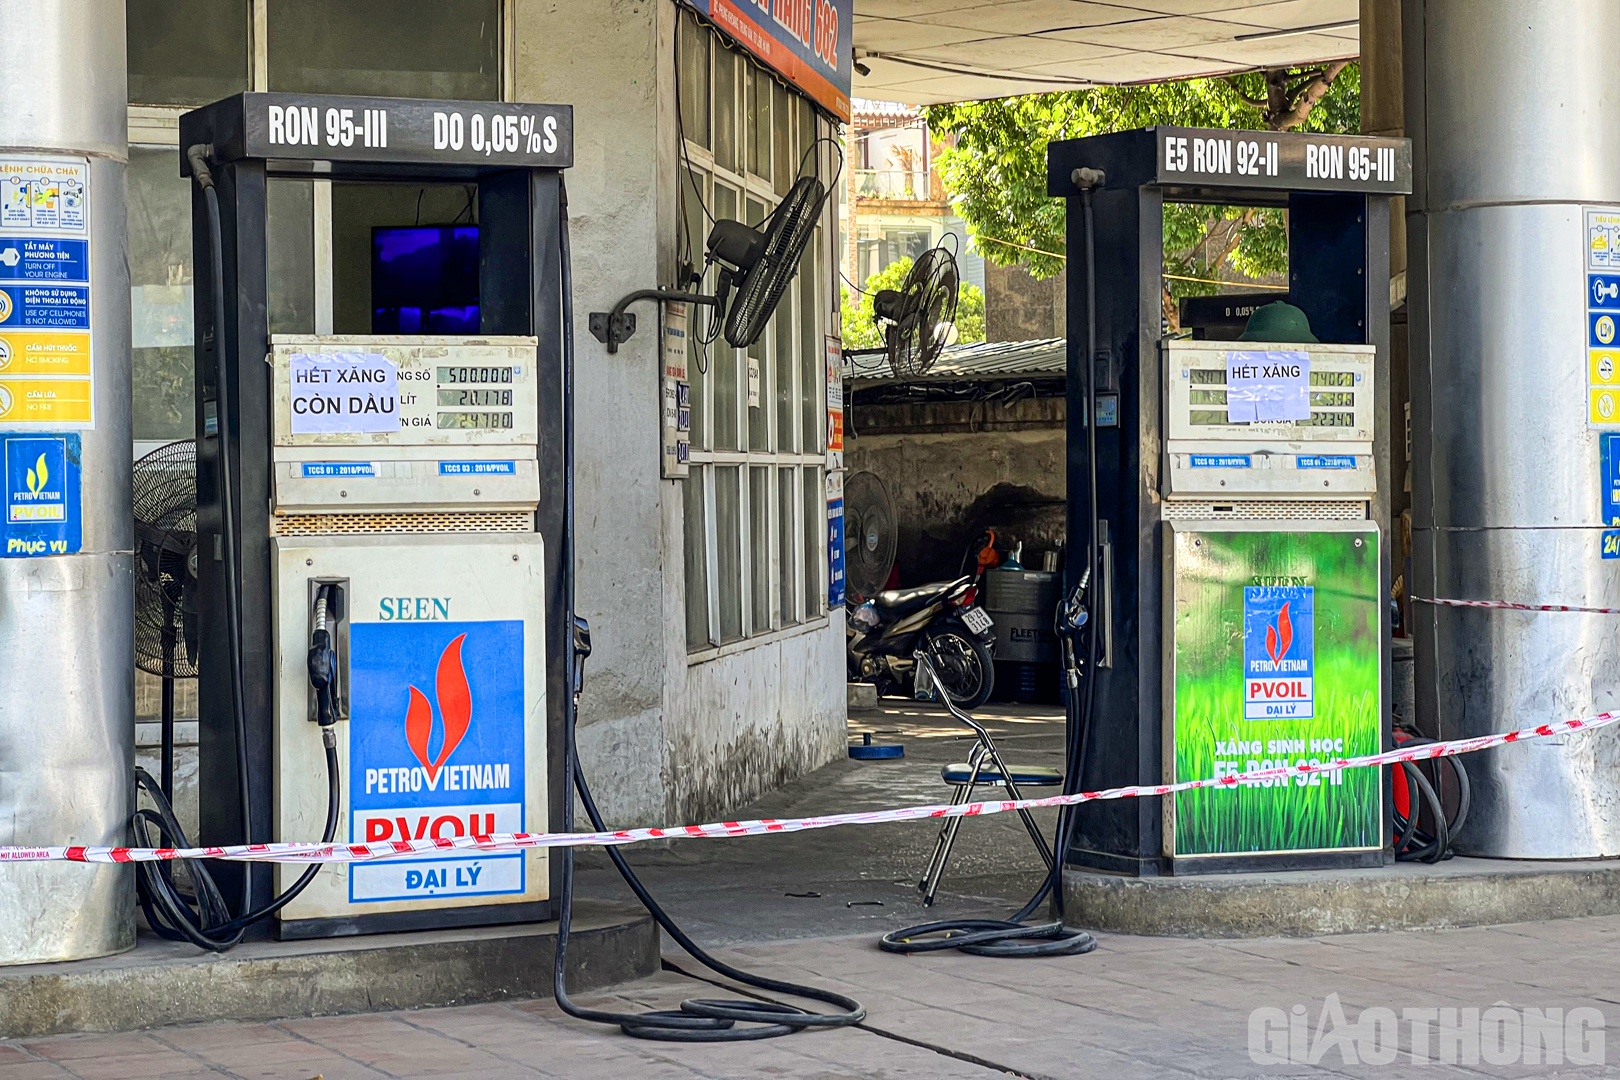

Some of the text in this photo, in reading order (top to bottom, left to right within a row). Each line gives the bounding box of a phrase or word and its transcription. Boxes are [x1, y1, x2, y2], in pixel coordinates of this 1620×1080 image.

[814, 0, 838, 72] 682
[268, 105, 387, 149] RON 95-III
[433, 112, 464, 151] DO
[1165, 136, 1279, 177] E5 RON 92-II
[1306, 143, 1395, 182] RON 95-III
[25, 251, 70, 261] PHƯƠNG TIỆN
[44, 271, 67, 279] ENGINE
[42, 297, 62, 305] THOẠI
[60, 290, 77, 298] DỤNG
[49, 310, 86, 318] CELLPHONES
[296, 364, 386, 383] HẾT XĂNG
[415, 367, 431, 381] SỐ
[449, 368, 510, 383] 500.000
[1262, 362, 1301, 379] XĂNG
[293, 390, 395, 415] CÒN DẦU
[400, 391, 417, 405] LÍT
[411, 413, 432, 427] GIÁ
[307, 466, 325, 475] TCCS
[325, 466, 334, 475] 01
[444, 464, 461, 473] TCCS
[14, 491, 61, 500] PETROVIETNAM
[7, 538, 68, 556] Phục vụ
[379, 596, 451, 621] SEEN
[1250, 659, 1308, 672] PETROVIETNAM
[1250, 681, 1307, 699] PVOIL
[1266, 702, 1297, 717] ĐẠI LÝ
[1215, 737, 1343, 757] XĂNG SINH HỌC
[366, 763, 510, 795] PETROVIETNAM
[11, 851, 35, 859] ALLOWED
[405, 861, 483, 895] ĐẠI LÝ
